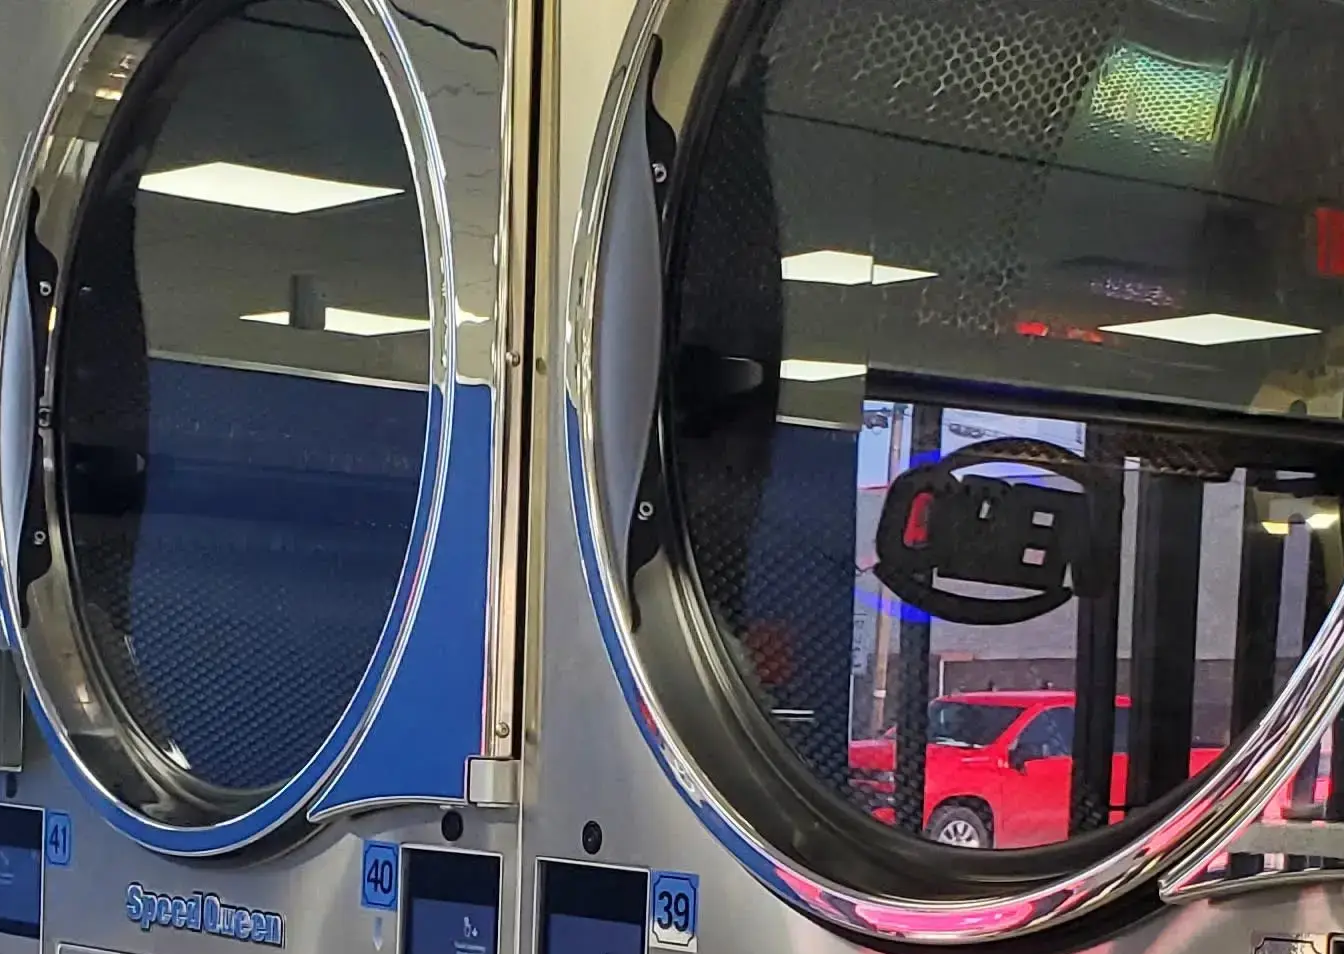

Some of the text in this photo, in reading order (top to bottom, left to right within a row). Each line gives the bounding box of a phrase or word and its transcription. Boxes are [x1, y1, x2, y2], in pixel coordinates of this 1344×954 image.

[49, 823, 67, 855] 41
[367, 858, 393, 894] 40
[126, 881, 286, 948] Speed Queen
[656, 890, 690, 932] 39
